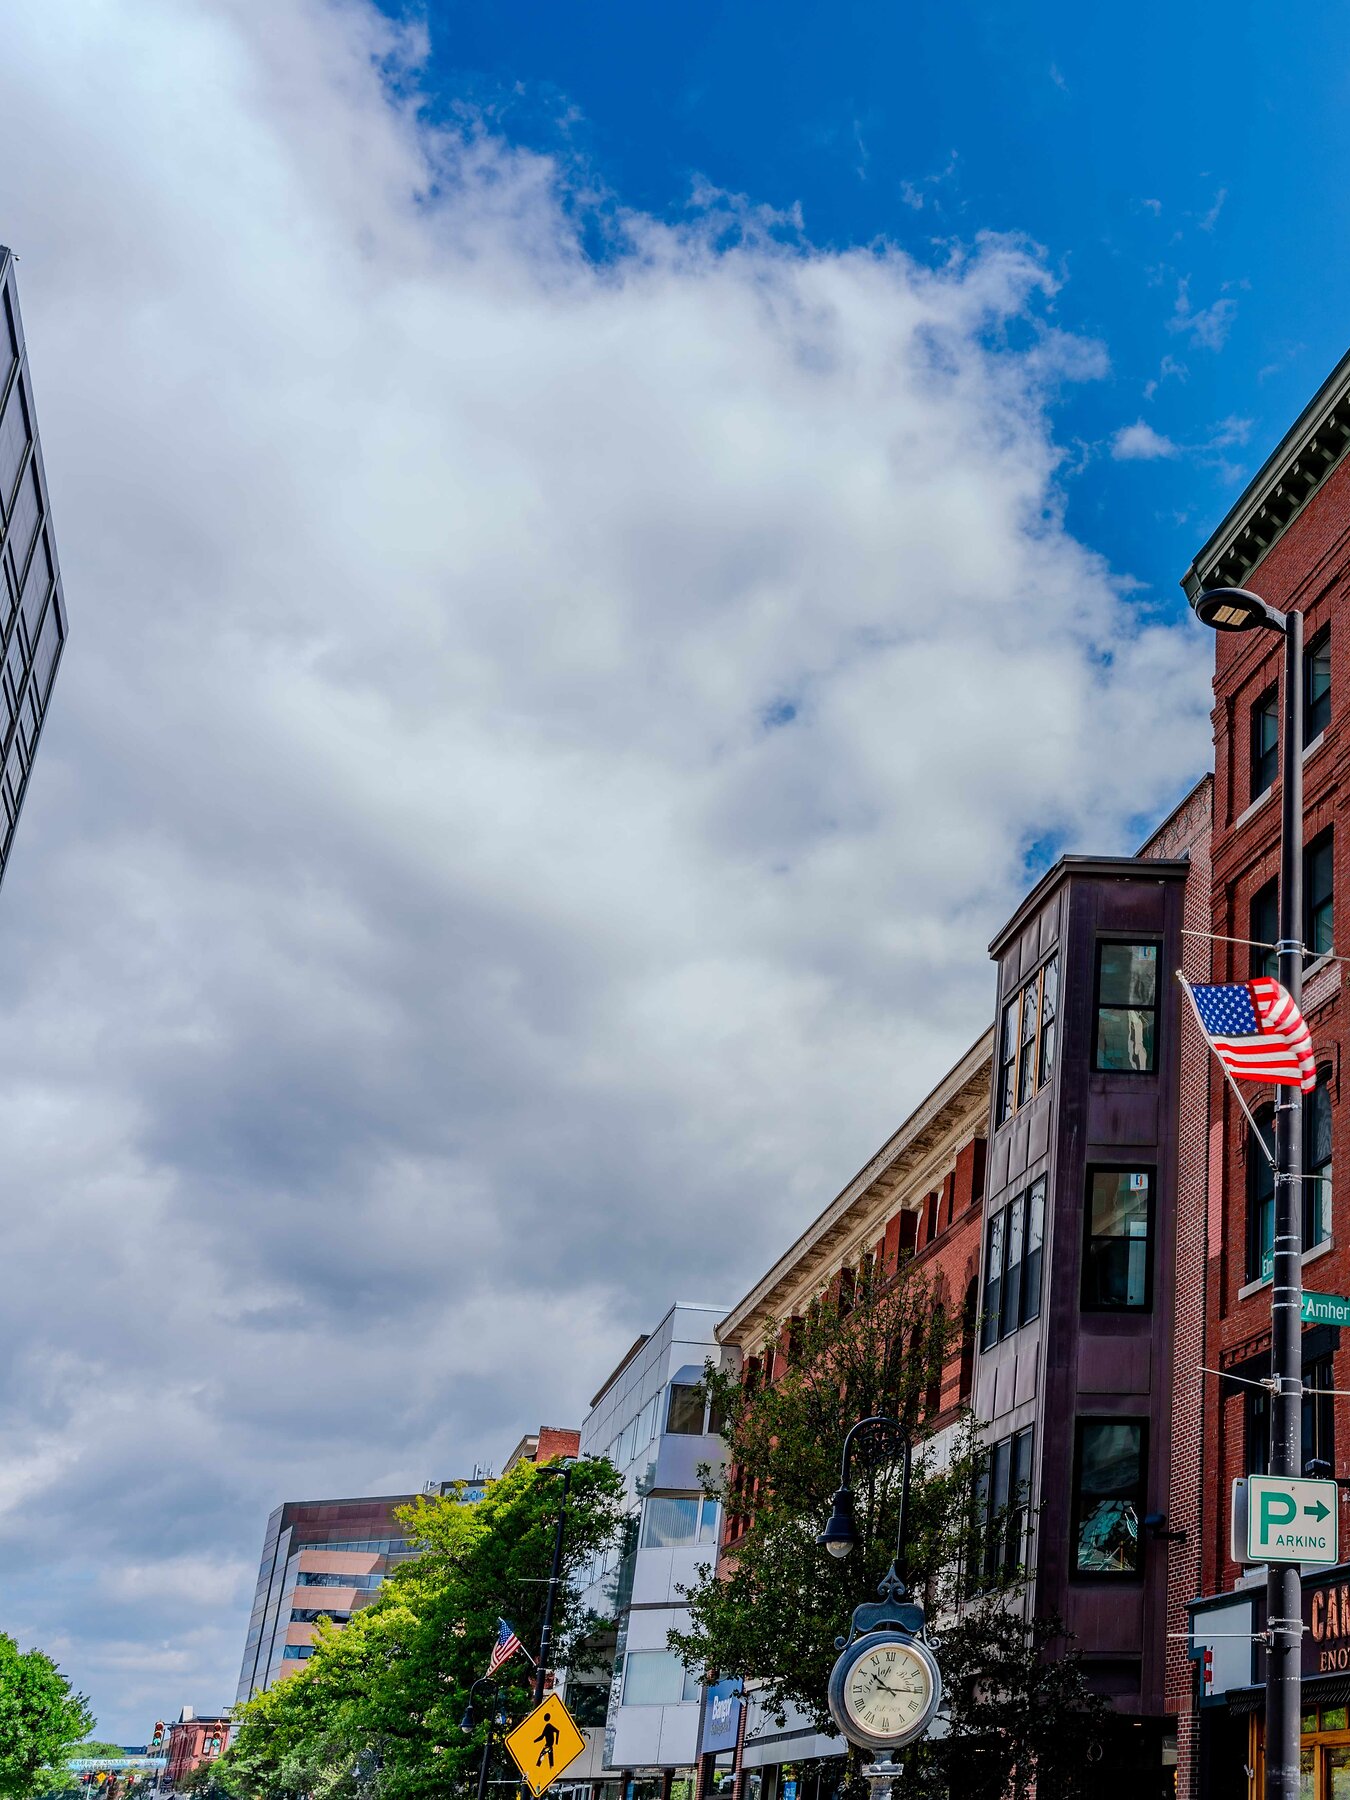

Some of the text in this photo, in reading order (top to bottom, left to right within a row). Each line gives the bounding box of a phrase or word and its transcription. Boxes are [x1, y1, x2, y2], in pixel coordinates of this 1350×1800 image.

[870, 1655, 880, 1667] XI
[885, 1651, 896, 1662] XII
[858, 1668, 868, 1677] X
[863, 1666, 892, 1694] Dulap
[853, 1685, 862, 1694] IX
